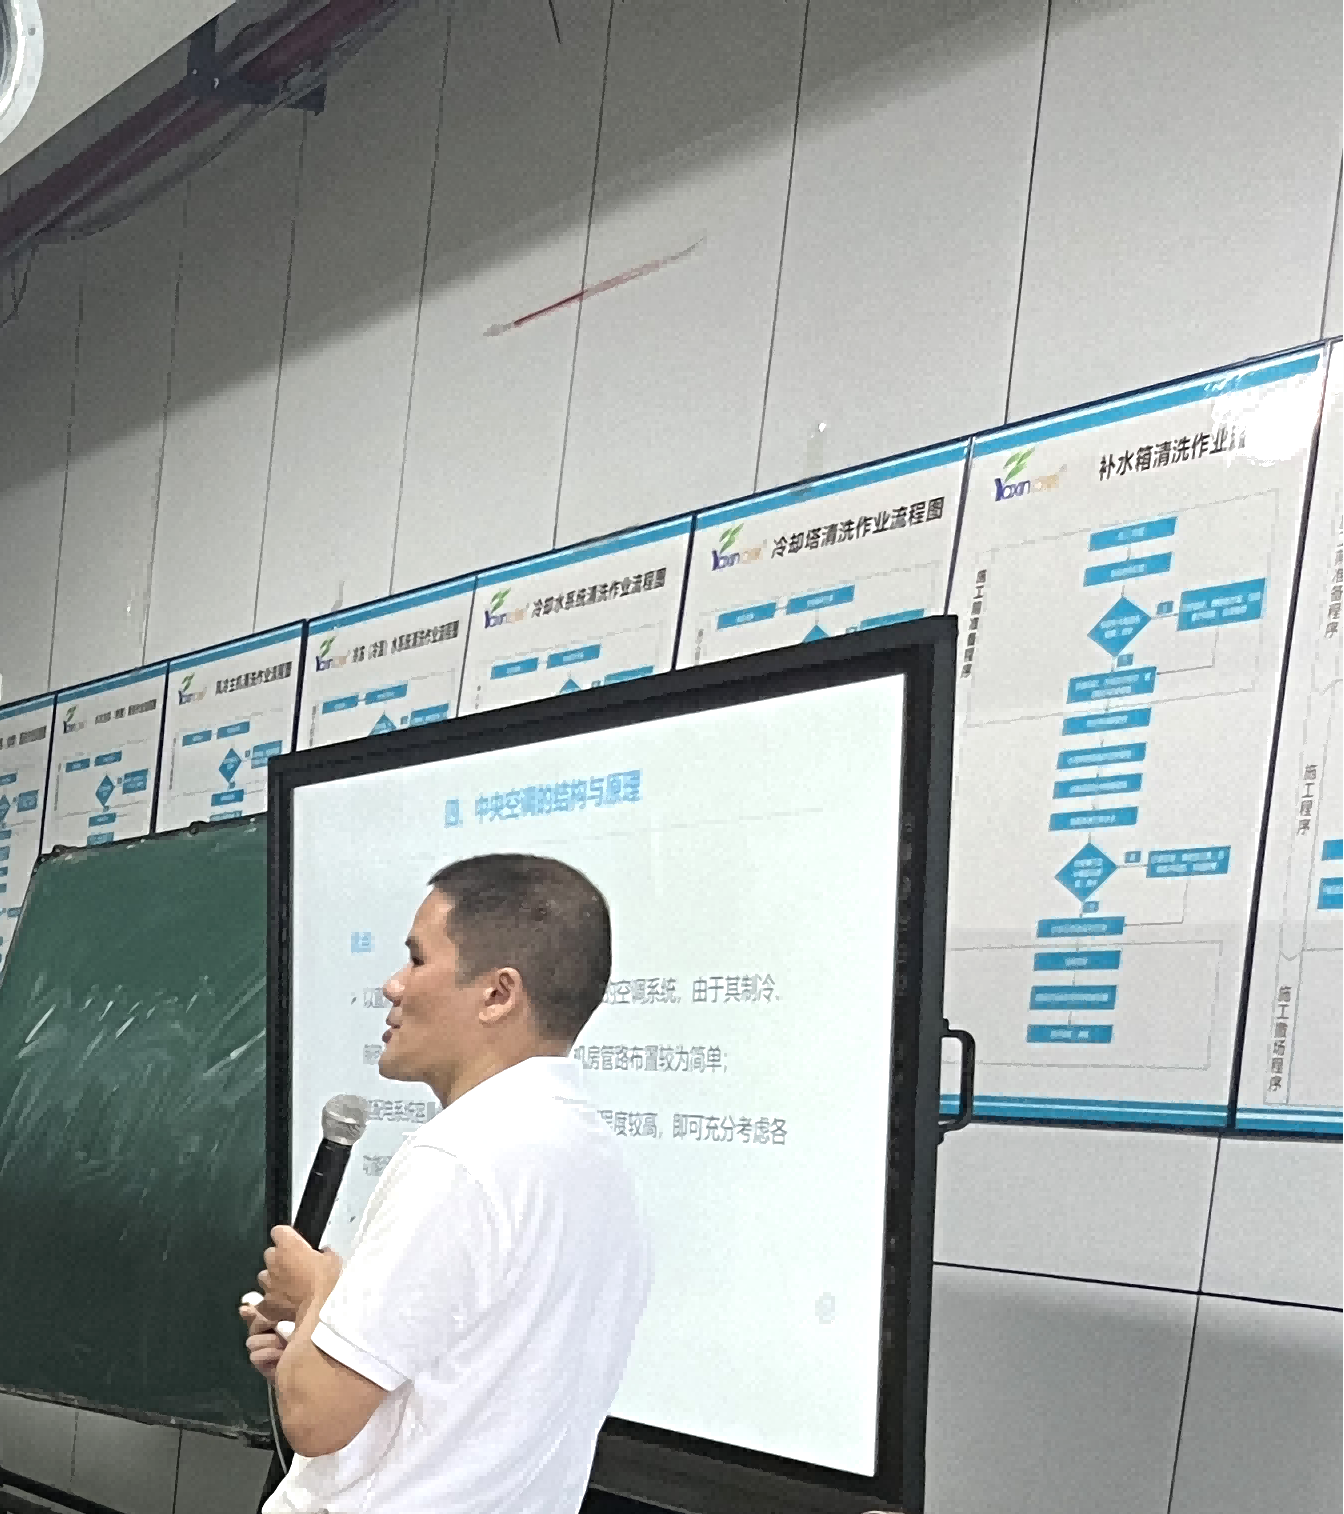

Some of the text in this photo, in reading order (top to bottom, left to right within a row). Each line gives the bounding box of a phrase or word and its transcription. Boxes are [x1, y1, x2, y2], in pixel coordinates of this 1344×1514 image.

[770, 496, 945, 559] 冷却塔清洗作业流程图
